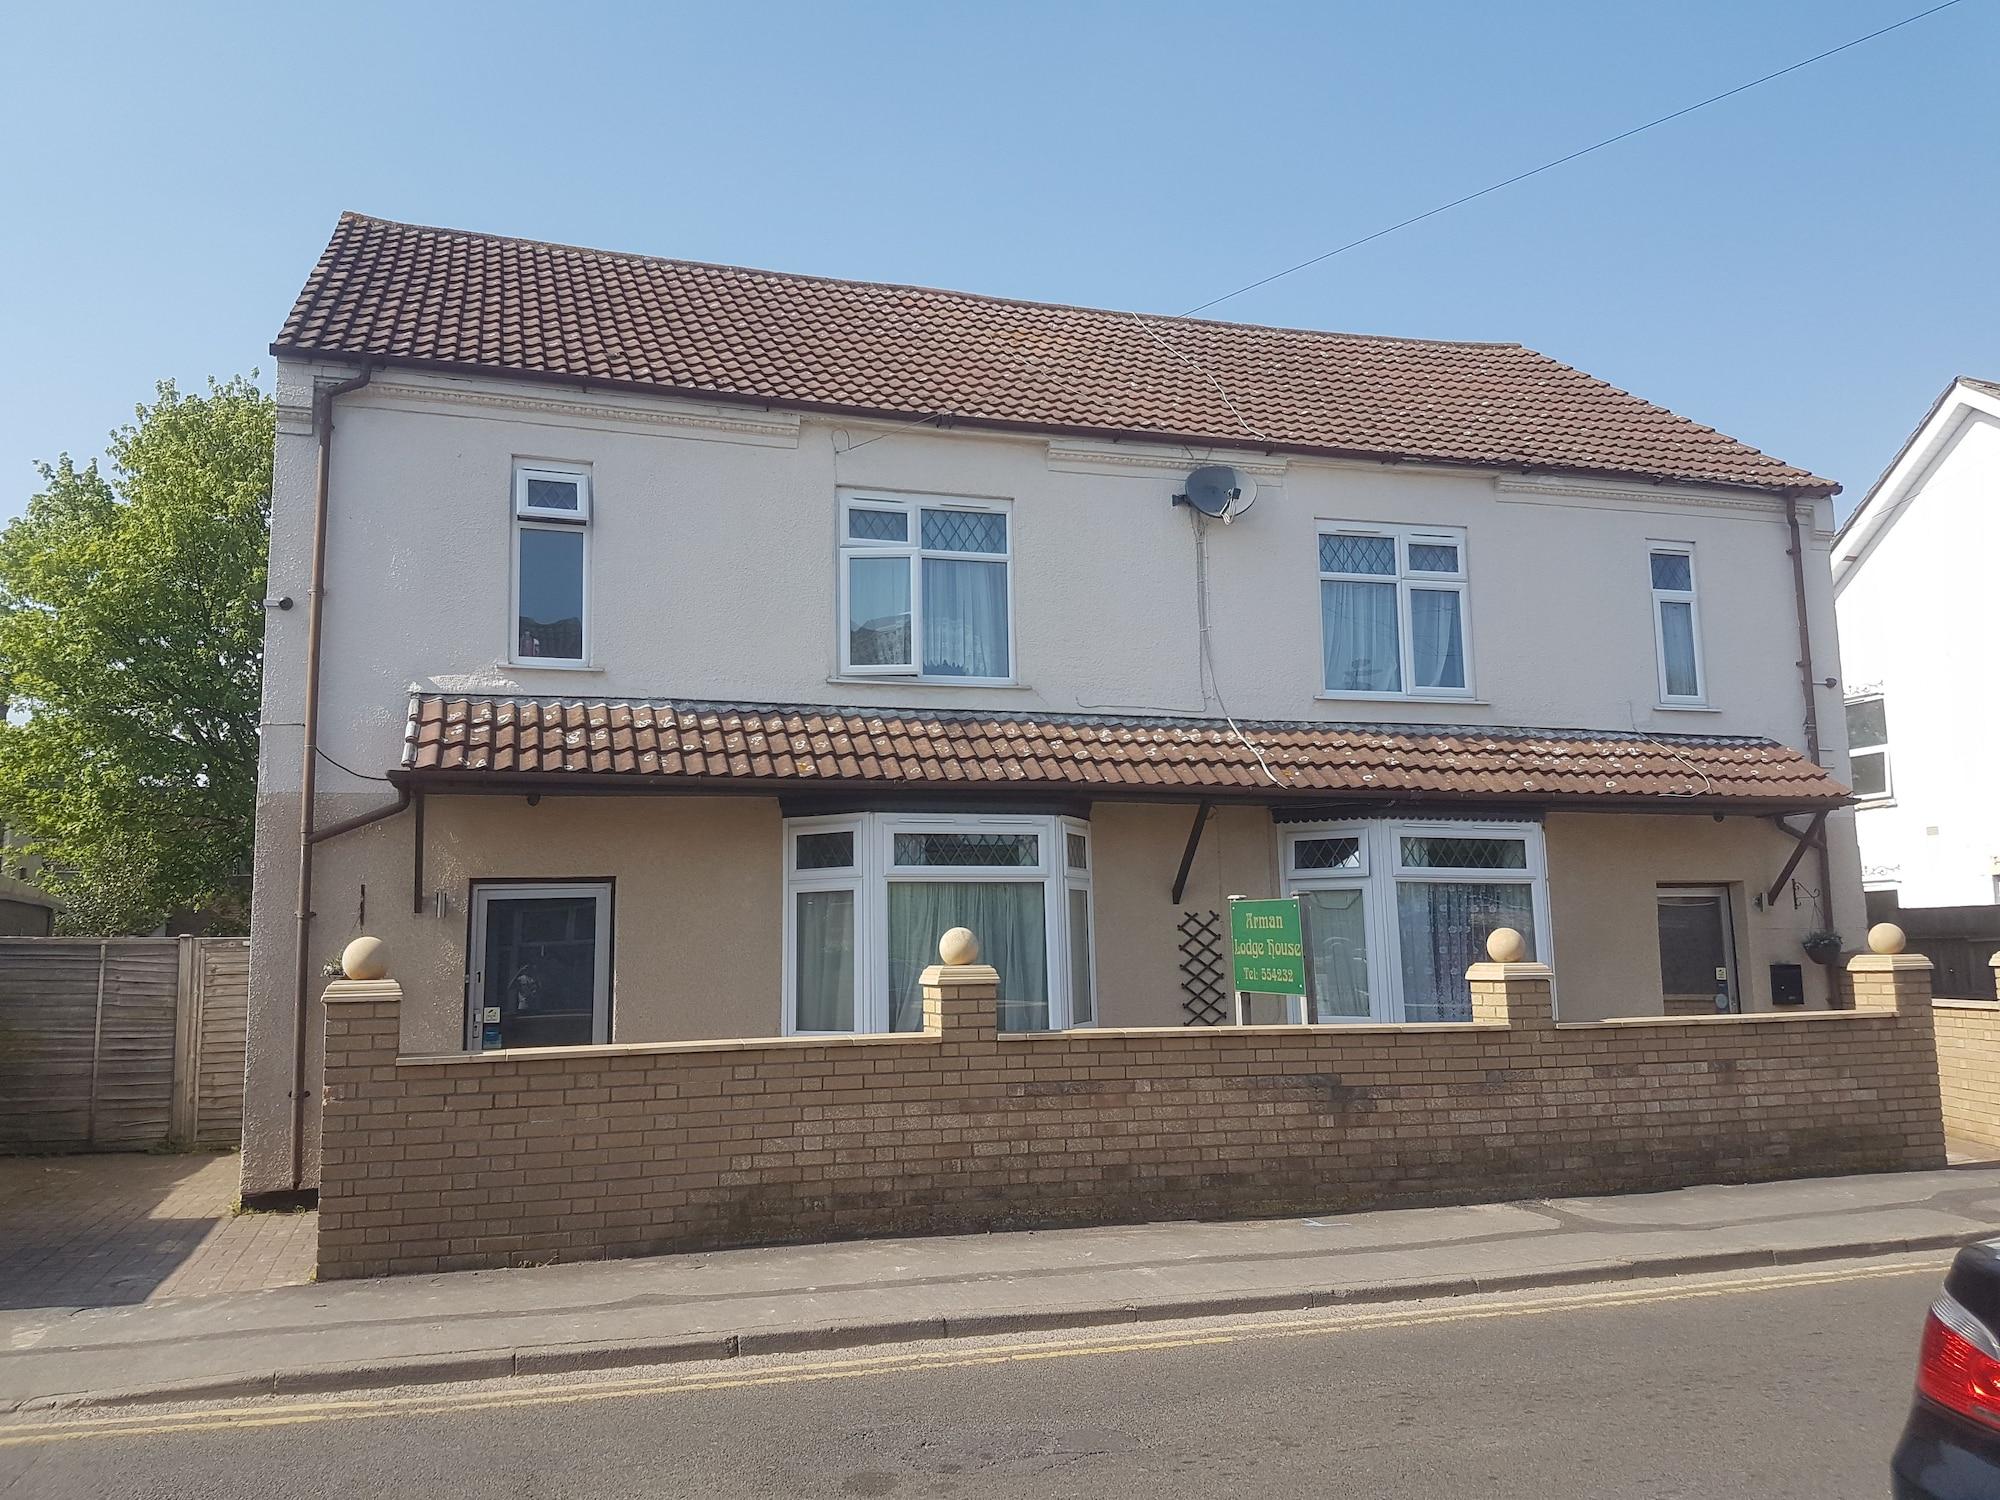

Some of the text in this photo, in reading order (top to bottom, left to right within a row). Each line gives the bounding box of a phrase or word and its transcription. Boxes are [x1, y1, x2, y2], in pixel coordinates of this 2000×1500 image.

[1246, 913, 1283, 929] Arman
[1234, 939, 1264, 958] Lodge
[1261, 968, 1293, 982] 554232
